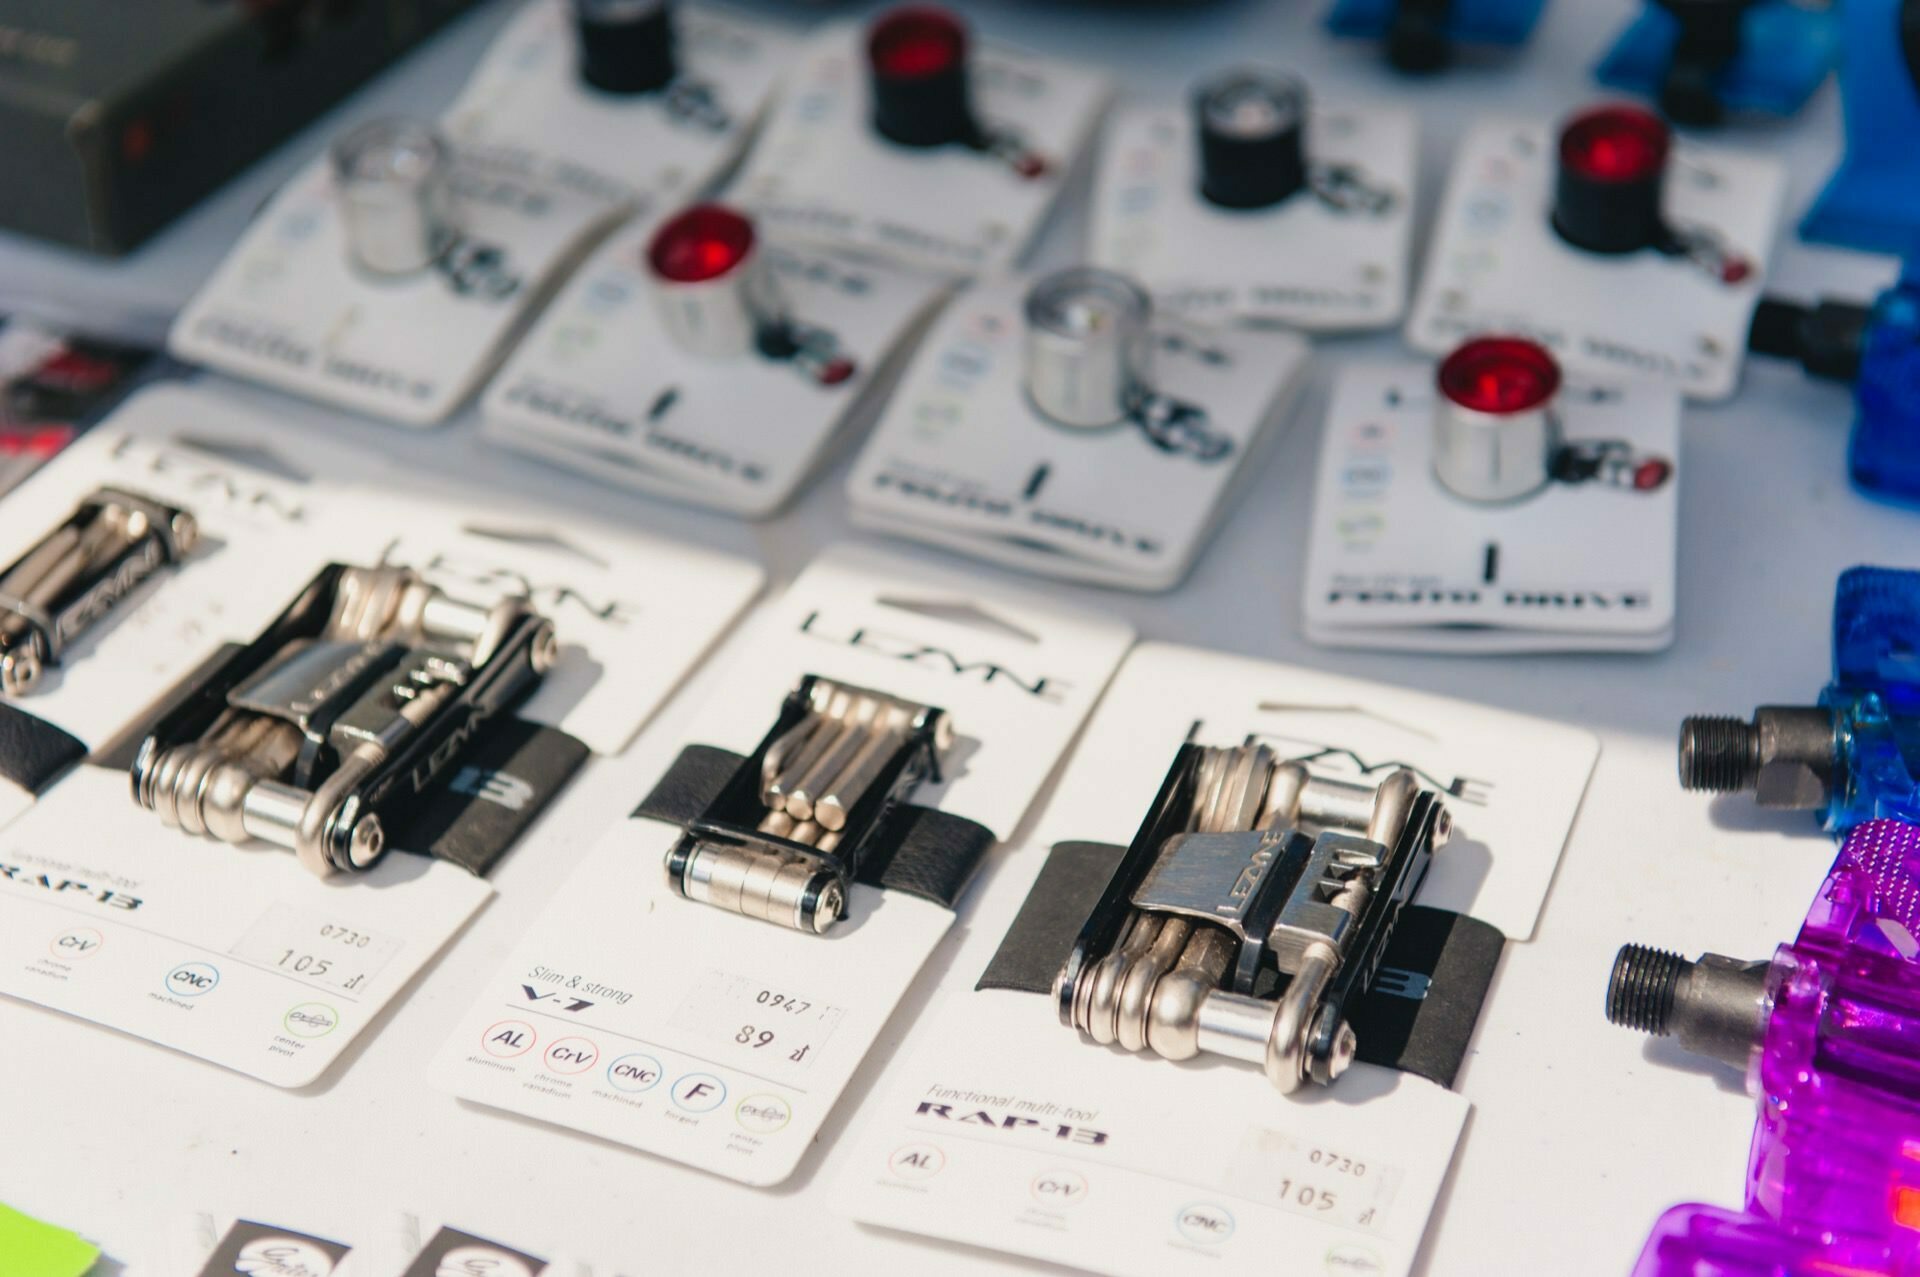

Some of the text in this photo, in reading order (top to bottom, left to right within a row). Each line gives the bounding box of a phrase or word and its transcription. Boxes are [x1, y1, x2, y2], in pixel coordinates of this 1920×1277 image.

[1214, 830, 1286, 914] LEZYNE
[58, 934, 96, 952] CrV
[319, 923, 372, 949] 0730
[278, 948, 334, 977] 105
[172, 969, 213, 989] CNC
[528, 965, 633, 1006] Slim & strong
[521, 983, 596, 1013] V-7
[756, 990, 812, 1015] 0947
[491, 1029, 524, 1049] AL
[735, 1024, 775, 1049] 89
[551, 1046, 593, 1065] CrV
[614, 1063, 656, 1084] CNC
[684, 1082, 716, 1101] F
[926, 1082, 1015, 1109] Functional
[915, 1100, 1110, 1146] RAP-13
[900, 1151, 932, 1170] AL
[1309, 1148, 1368, 1178] 0730
[1278, 1178, 1339, 1211] 105
